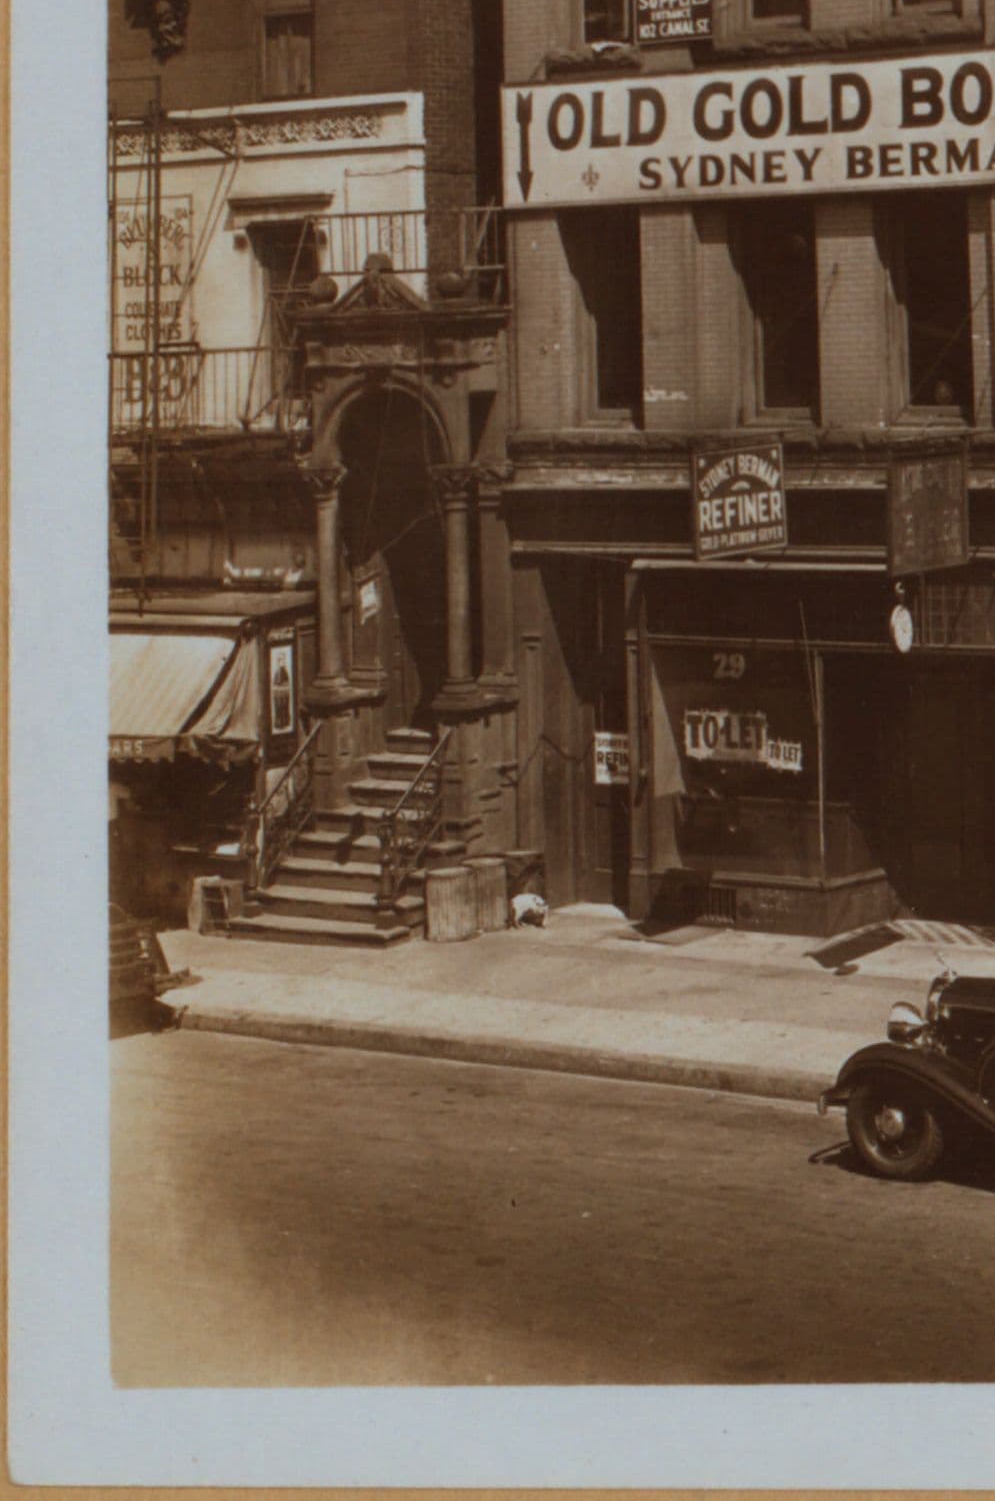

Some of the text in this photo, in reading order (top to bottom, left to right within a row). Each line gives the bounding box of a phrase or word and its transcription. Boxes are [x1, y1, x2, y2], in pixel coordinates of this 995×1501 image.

[659, 19, 695, 37] CANAL
[545, 86, 667, 152] OLD
[692, 71, 873, 145] GOLD
[638, 146, 824, 191] SYDNEY
[698, 491, 782, 532] REFINER
[713, 653, 745, 679] 29
